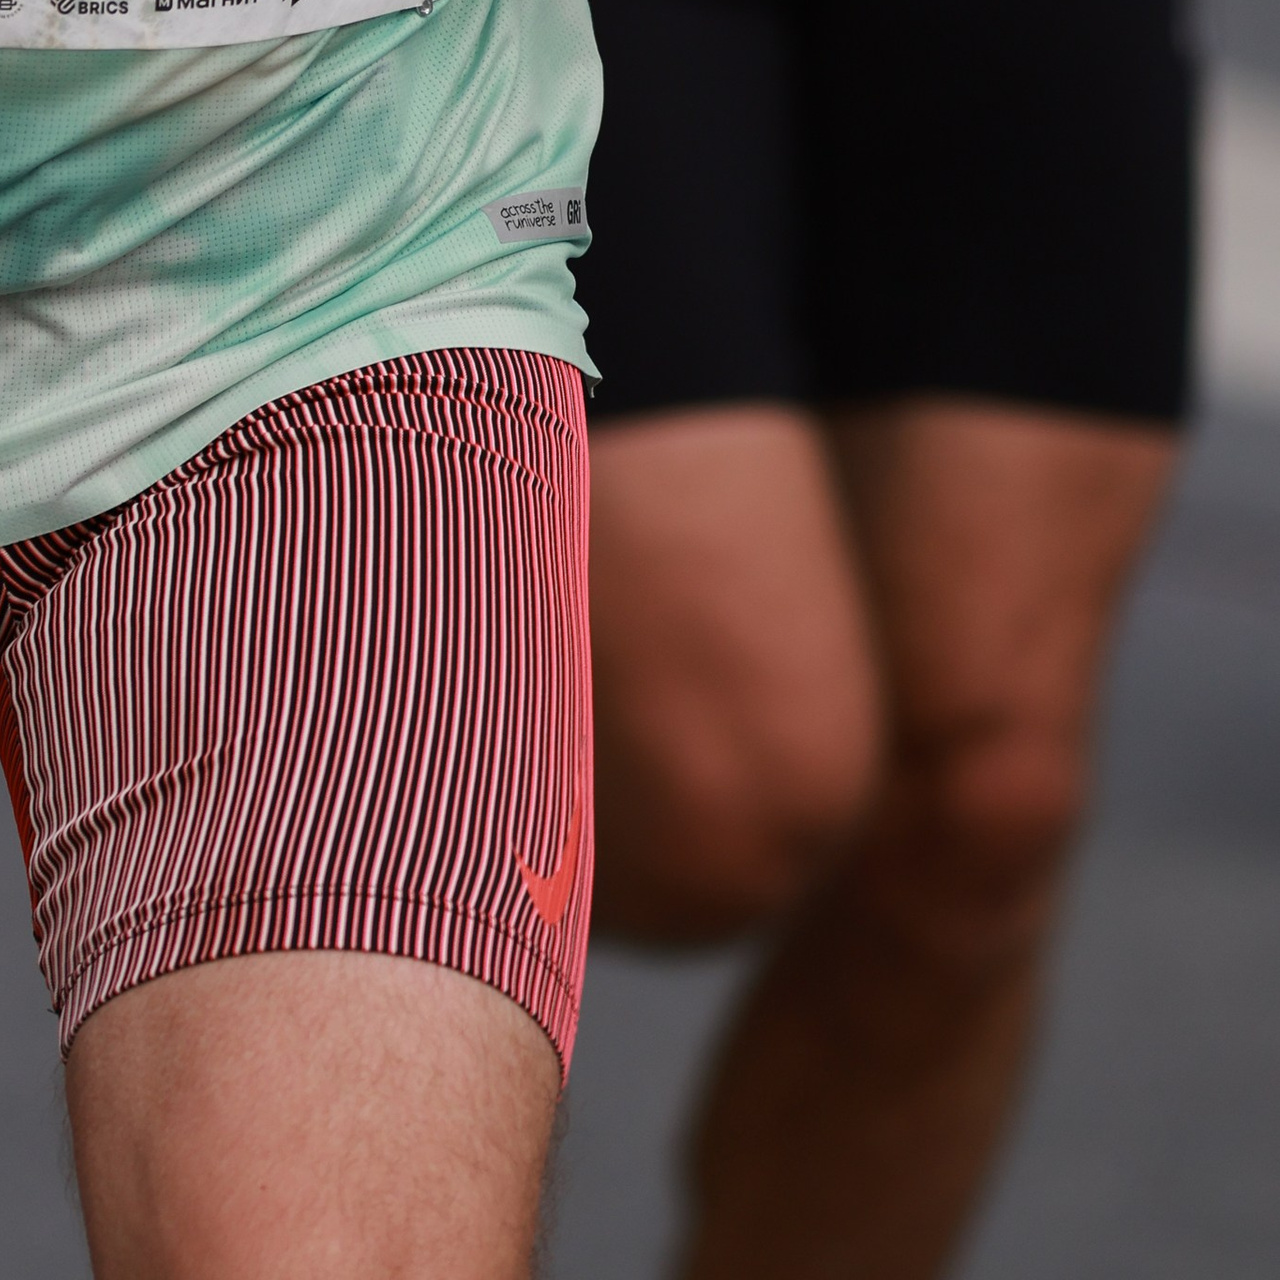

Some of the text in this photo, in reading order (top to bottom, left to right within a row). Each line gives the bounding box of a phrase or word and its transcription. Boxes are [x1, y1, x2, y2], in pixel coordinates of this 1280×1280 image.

[78, 1, 129, 15] BRICS
[500, 197, 554, 219] across the
[505, 214, 556, 231] runiverse
